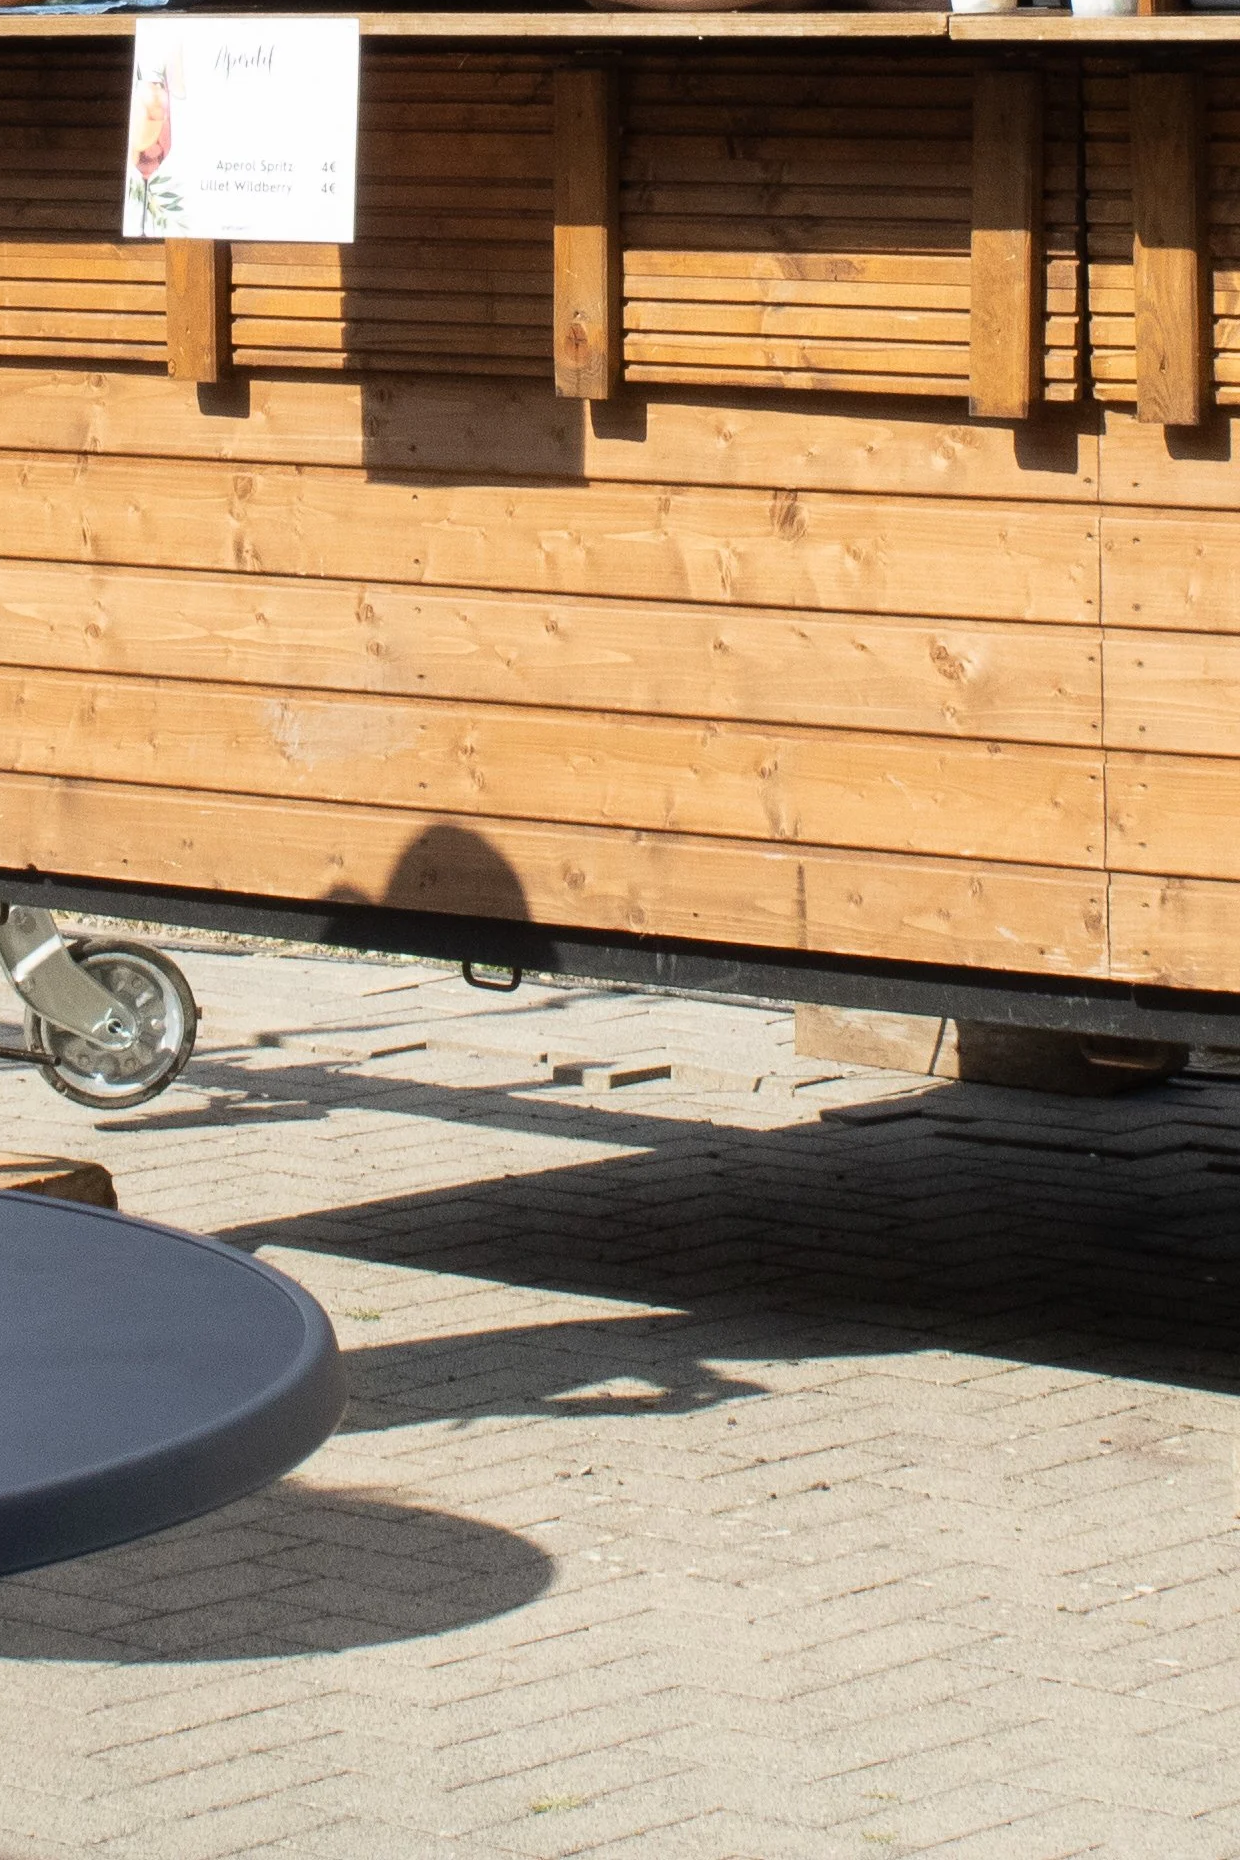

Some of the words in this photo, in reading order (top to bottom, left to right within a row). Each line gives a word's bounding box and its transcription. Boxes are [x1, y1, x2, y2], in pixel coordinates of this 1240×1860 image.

[216, 159, 257, 174] Aperol
[259, 159, 294, 175] Spritz
[199, 179, 230, 193] Lillet
[234, 179, 293, 197] Wildberry
